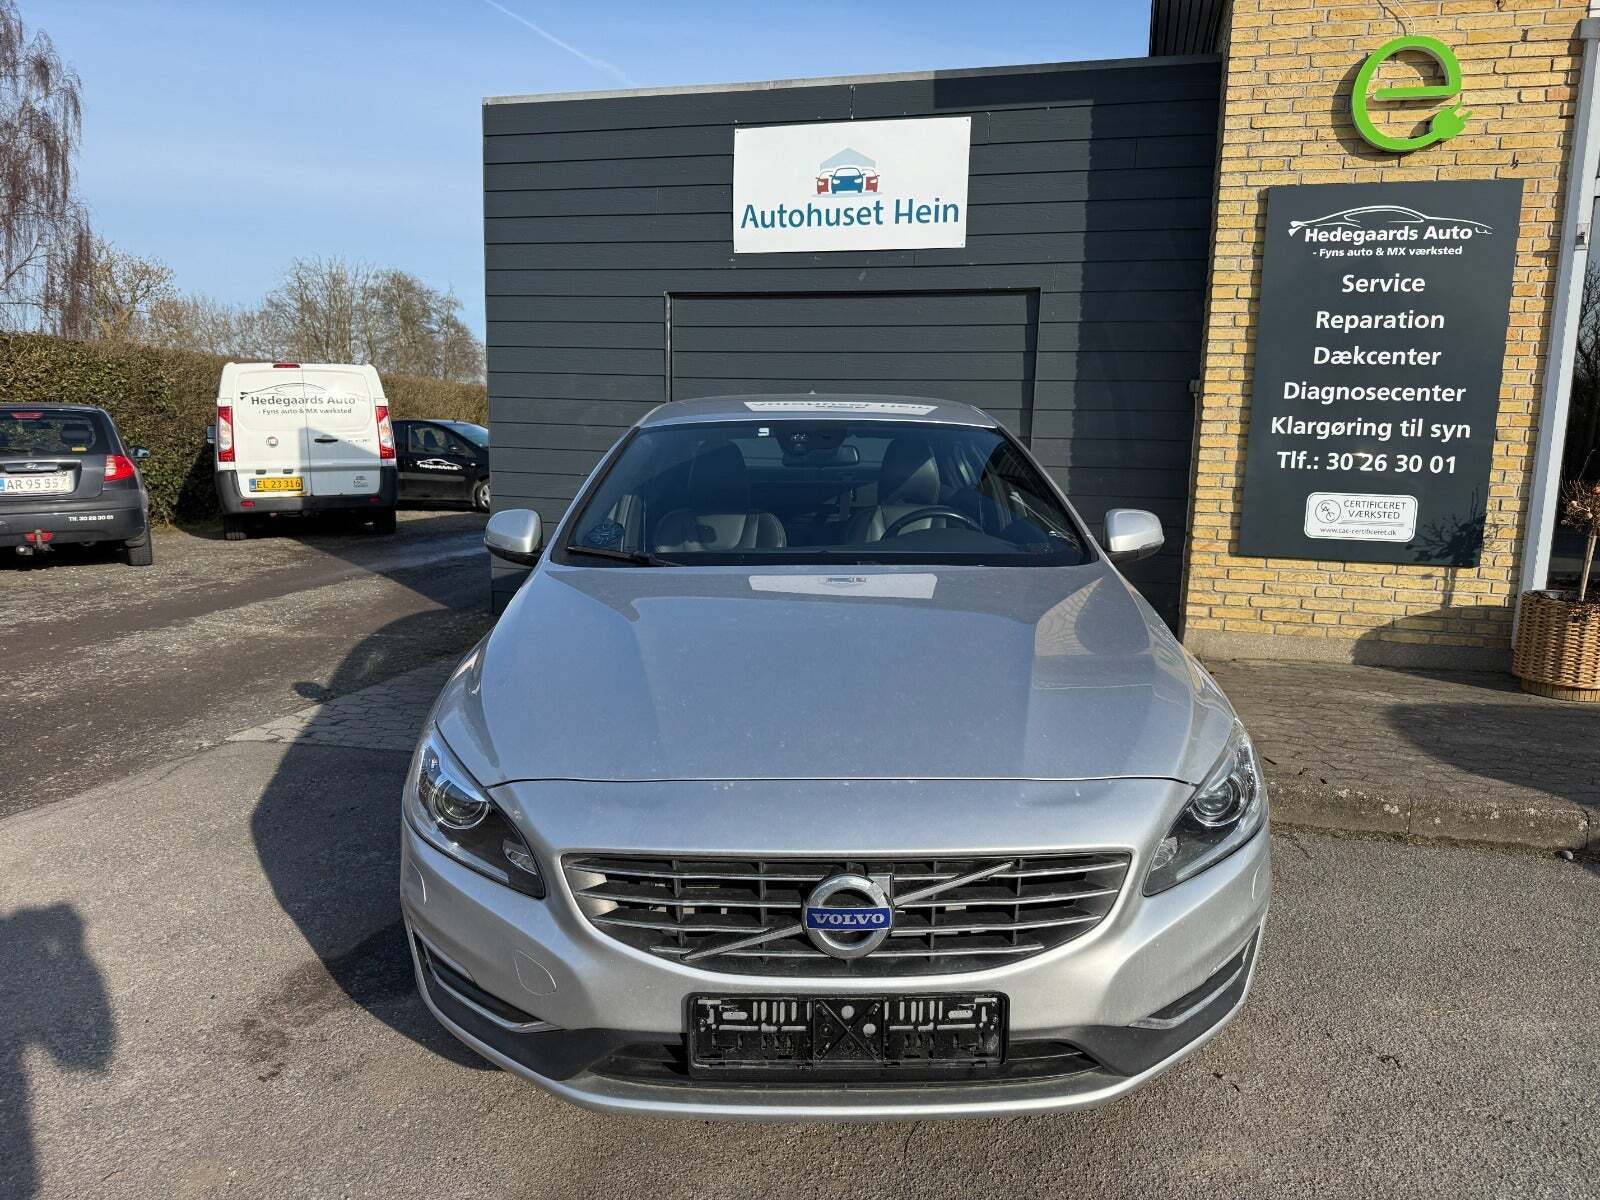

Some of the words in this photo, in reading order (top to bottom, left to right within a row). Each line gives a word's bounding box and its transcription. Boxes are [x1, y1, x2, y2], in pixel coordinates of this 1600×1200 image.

[740, 200, 884, 228] Autohuset
[894, 198, 959, 225] Hein
[1304, 226, 1418, 245] Hedegaards
[1423, 226, 1473, 240] Auto
[1319, 248, 1344, 259] Fyns
[1347, 248, 1373, 256] auto
[1376, 248, 1384, 256] &
[1387, 247, 1406, 256] MX
[1409, 246, 1463, 255] værksted
[1341, 273, 1426, 293] Service
[1315, 310, 1445, 333] Reparation
[1313, 346, 1442, 366] Dækcenter
[251, 395, 324, 407] Hedegaards
[327, 396, 356, 405] Auto
[1283, 381, 1467, 405] Diagnosecenter
[1271, 416, 1392, 441] Klargøring
[1400, 418, 1423, 438] til
[1430, 423, 1471, 442] syn
[1277, 451, 1319, 470] Tlf.:
[1326, 452, 1353, 471] 30
[1359, 453, 1388, 472] 26
[1394, 454, 1422, 473] 30
[1429, 455, 1456, 474] 01
[6, 479, 23, 490] AR
[25, 479, 41, 489] 95
[256, 481, 269, 489] EL
[284, 480, 301, 488] 316
[1343, 500, 1406, 510] CERTIFICERET
[1348, 510, 1400, 519] VÆRKSTED
[1319, 527, 1397, 536] www.cac-certificeret.dk
[811, 913, 885, 925] VOLVO
